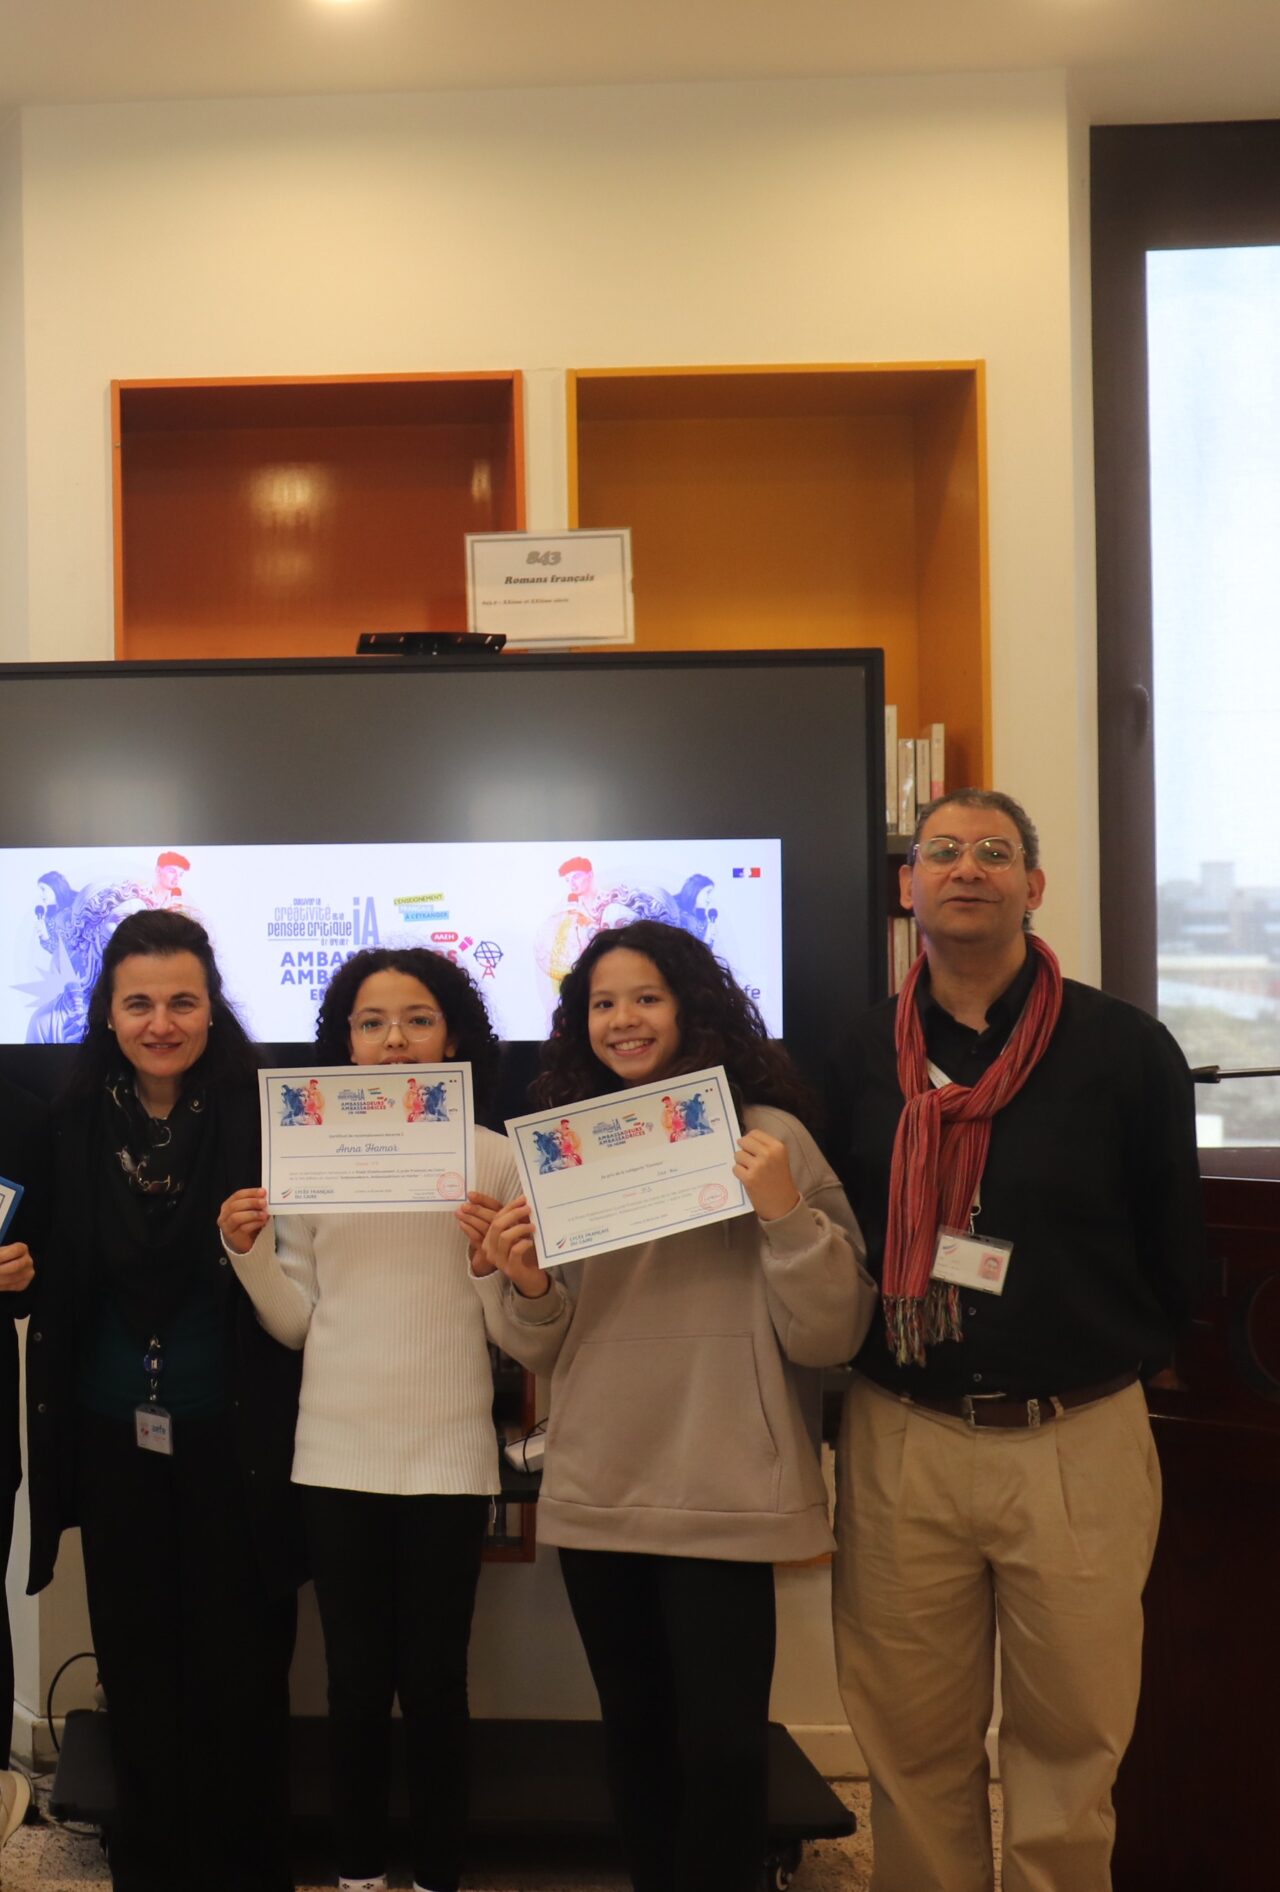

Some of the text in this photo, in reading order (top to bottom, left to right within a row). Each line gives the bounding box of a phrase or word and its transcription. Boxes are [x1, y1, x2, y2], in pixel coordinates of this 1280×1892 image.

[503, 573, 595, 585] Romans français
[267, 920, 352, 937] pensée critique
[280, 969, 341, 985] AMB
[335, 1143, 362, 1153] Anna
